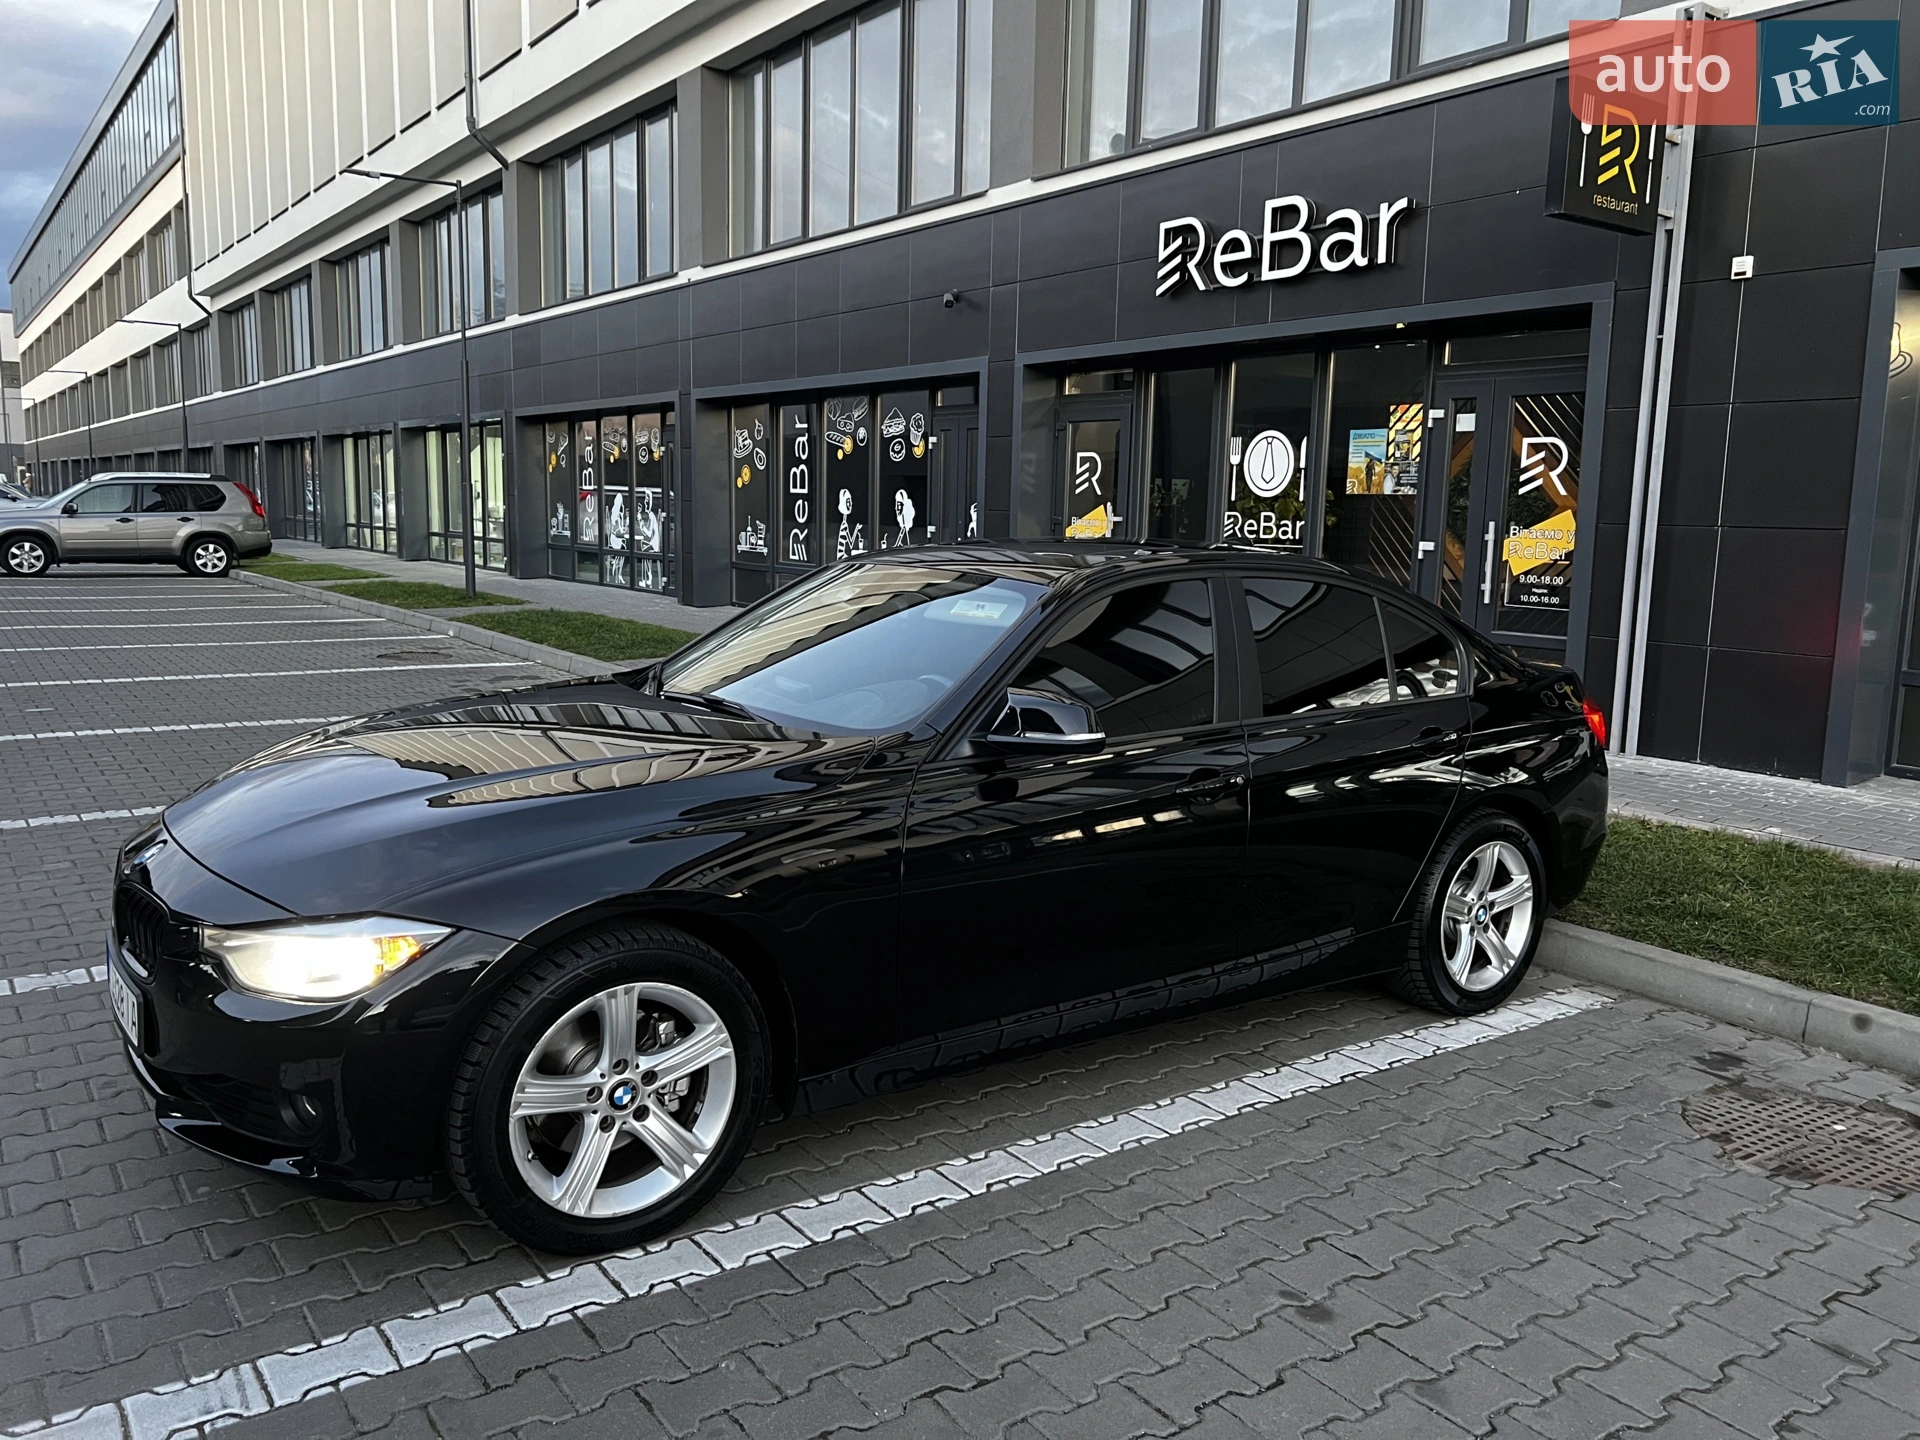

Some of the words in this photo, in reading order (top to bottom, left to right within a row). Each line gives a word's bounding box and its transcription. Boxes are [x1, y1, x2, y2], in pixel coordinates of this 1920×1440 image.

[1592, 193, 1639, 216] restaurant
[1155, 194, 1412, 297] ReBar
[582, 428, 595, 542] ReBar
[789, 414, 809, 561] ReBar
[1223, 511, 1305, 540] ReBar
[1509, 525, 1564, 541] Вітаємо
[1508, 540, 1570, 561] ReBar
[1519, 574, 1564, 586] 9.00-18.00
[1519, 594, 1560, 605] 10.00-16.00
